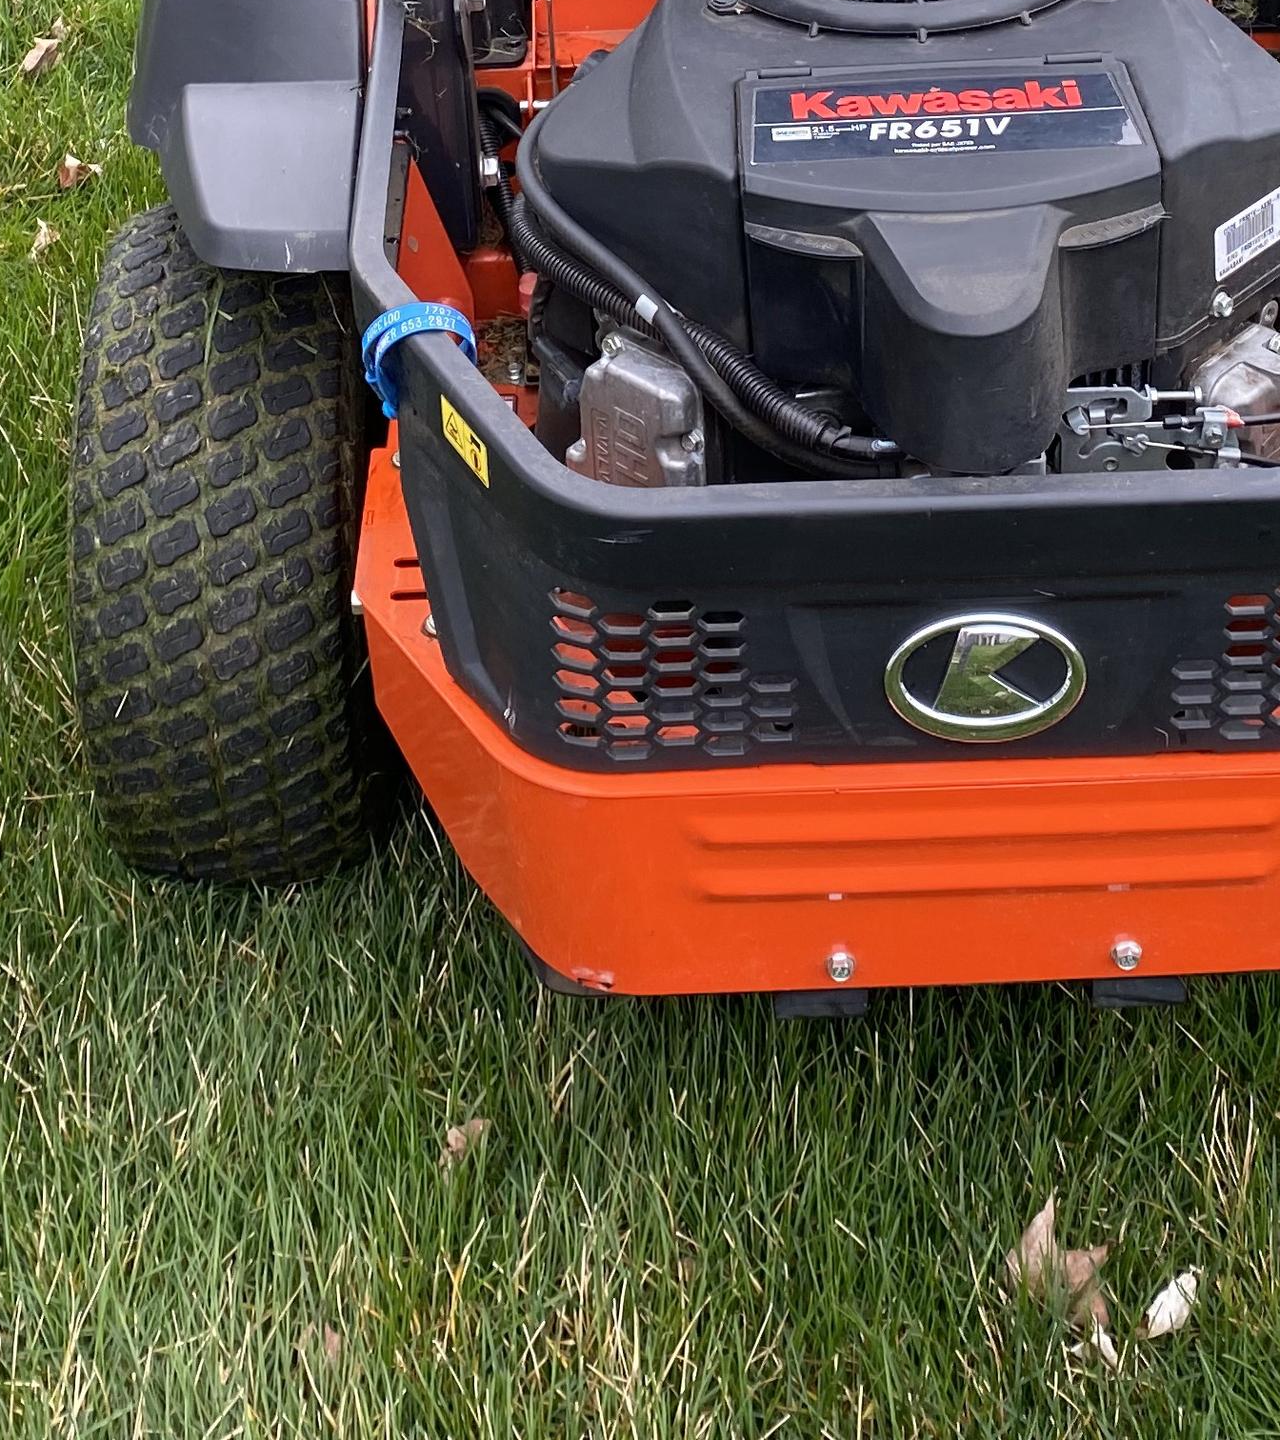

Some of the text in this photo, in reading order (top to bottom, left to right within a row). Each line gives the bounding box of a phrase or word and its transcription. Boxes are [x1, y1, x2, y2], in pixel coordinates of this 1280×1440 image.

[790, 80, 1083, 120] Kawasaki
[869, 116, 1011, 141] FR651V
[400, 317, 422, 333] 653
[427, 315, 457, 329] 2827
